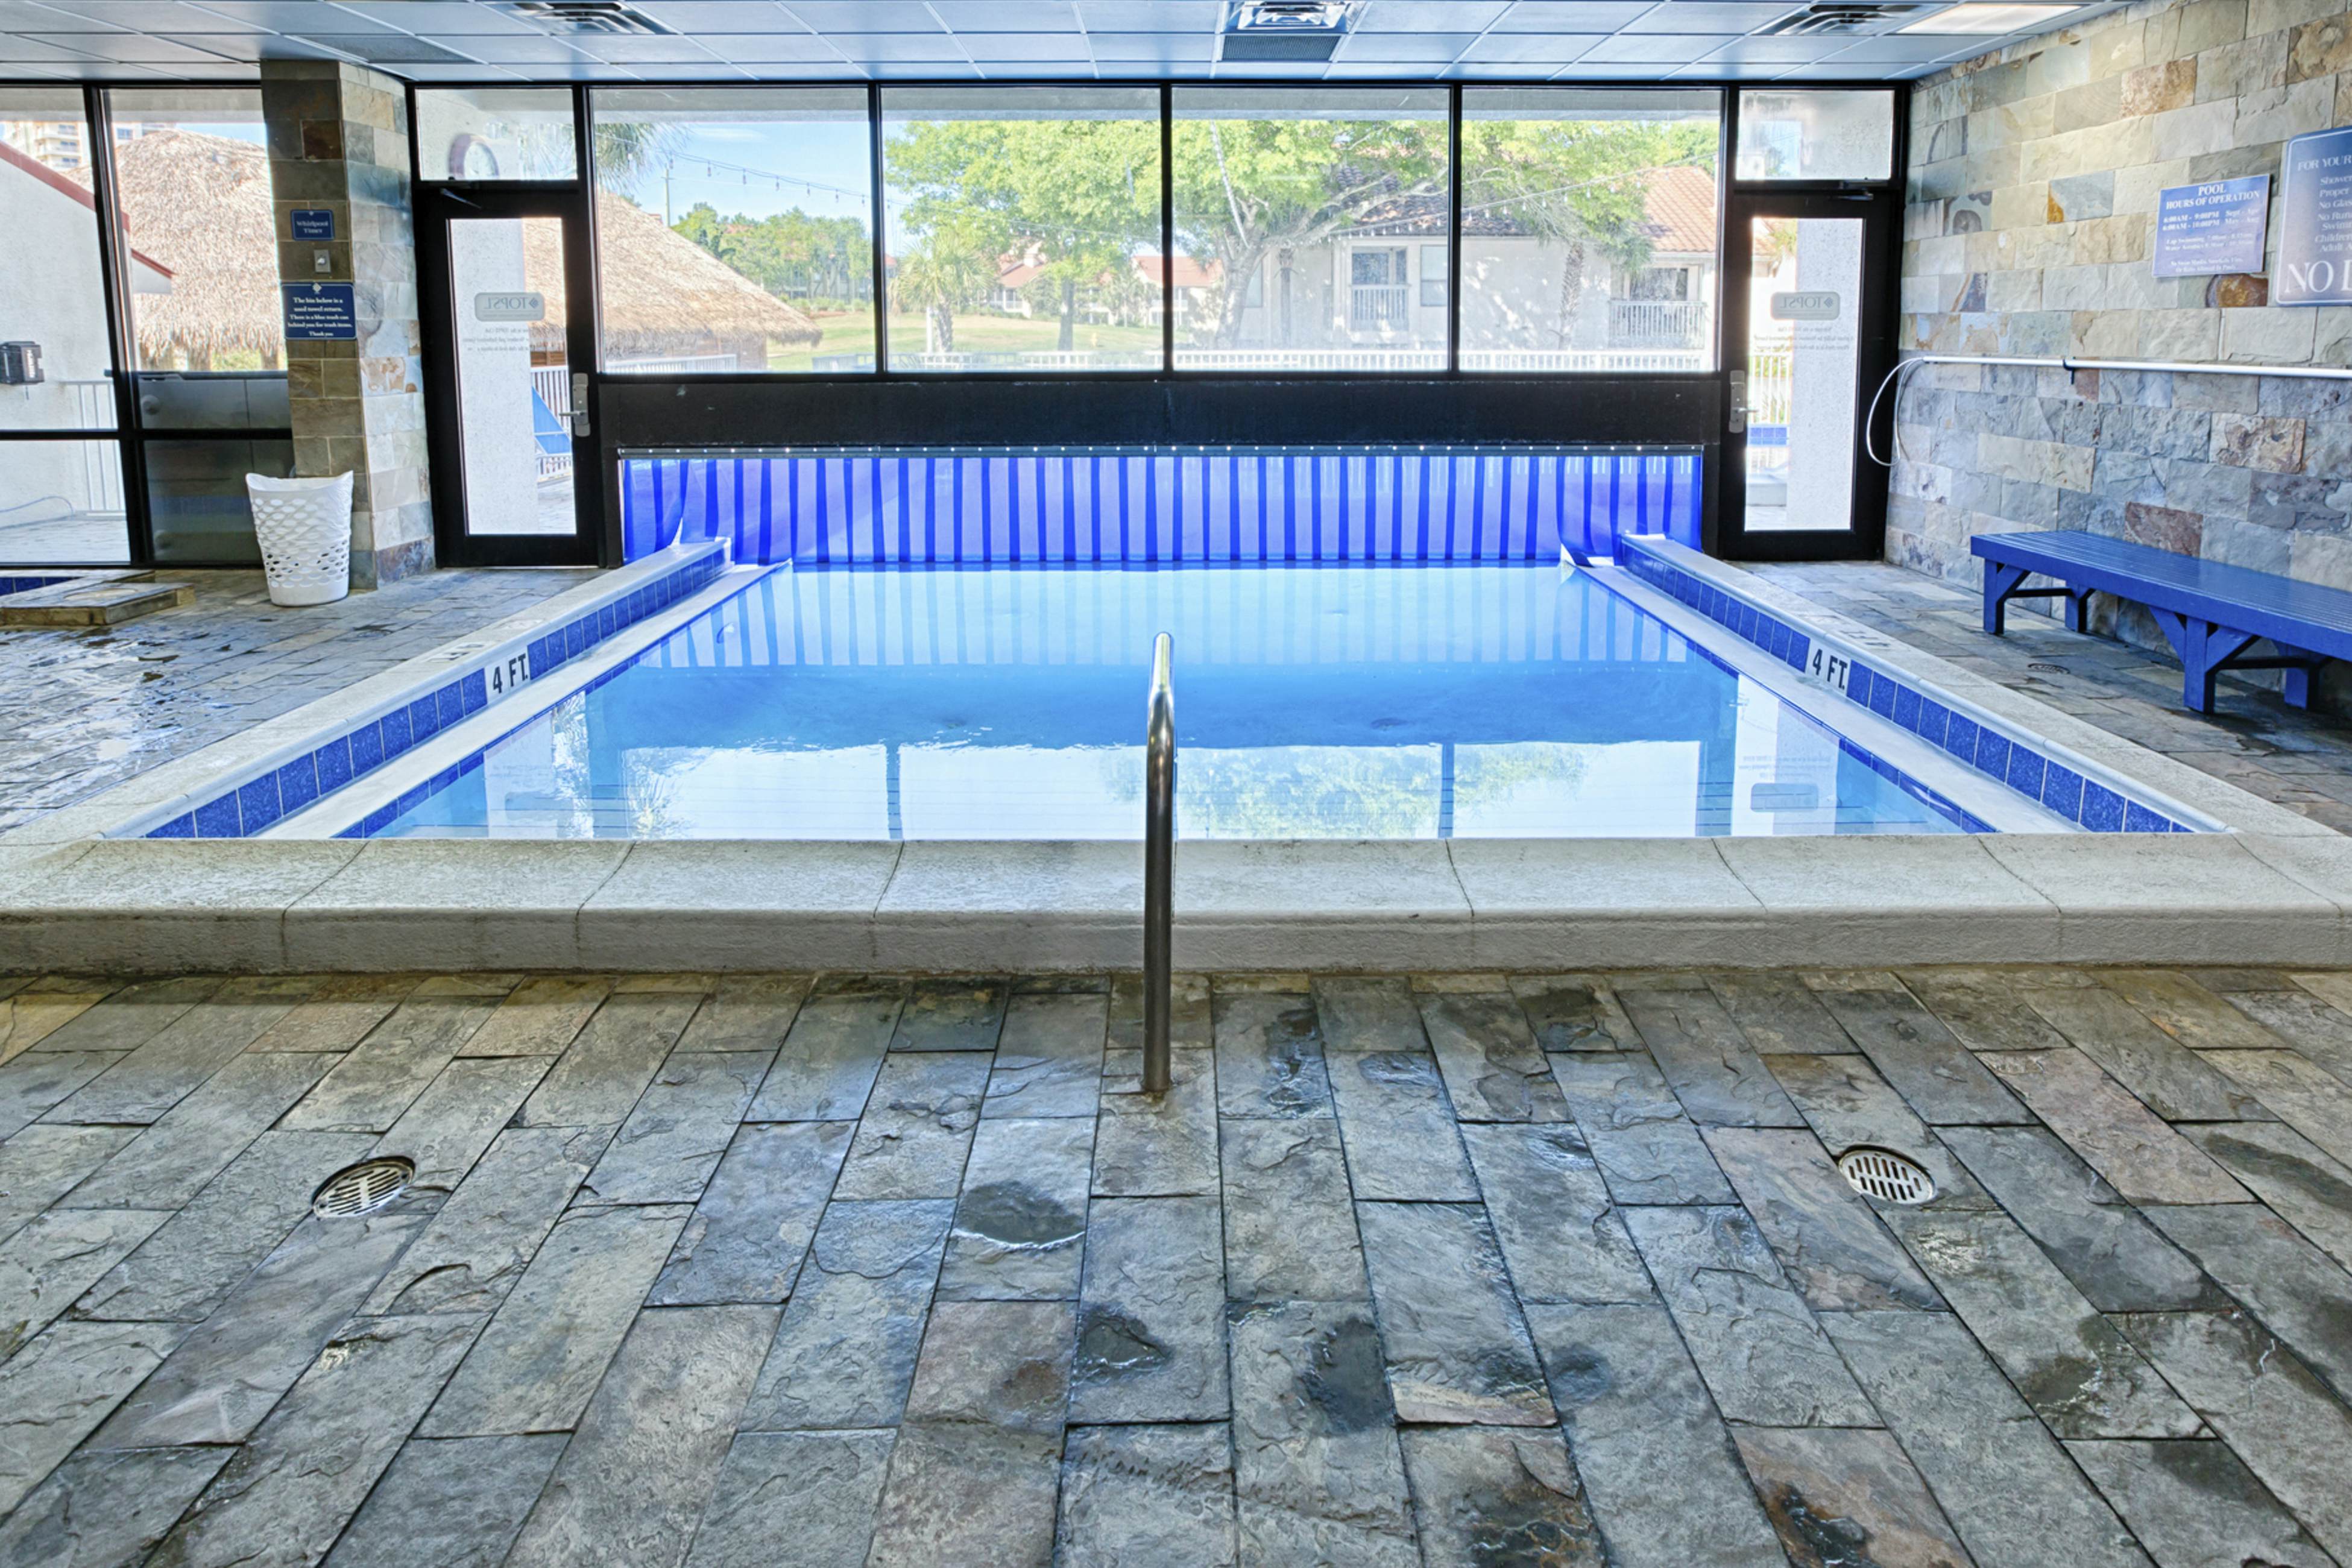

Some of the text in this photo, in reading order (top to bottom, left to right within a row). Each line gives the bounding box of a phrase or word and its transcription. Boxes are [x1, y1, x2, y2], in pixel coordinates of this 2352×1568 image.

[2298, 155, 2351, 171] FOR YOUR
[2166, 189, 2260, 209] HOURS OF OPERATION
[2198, 183, 2227, 196] POOL
[2284, 260, 2334, 293] NO
[493, 653, 528, 694] 4 FT.
[1812, 649, 1848, 690] 4 FT.
